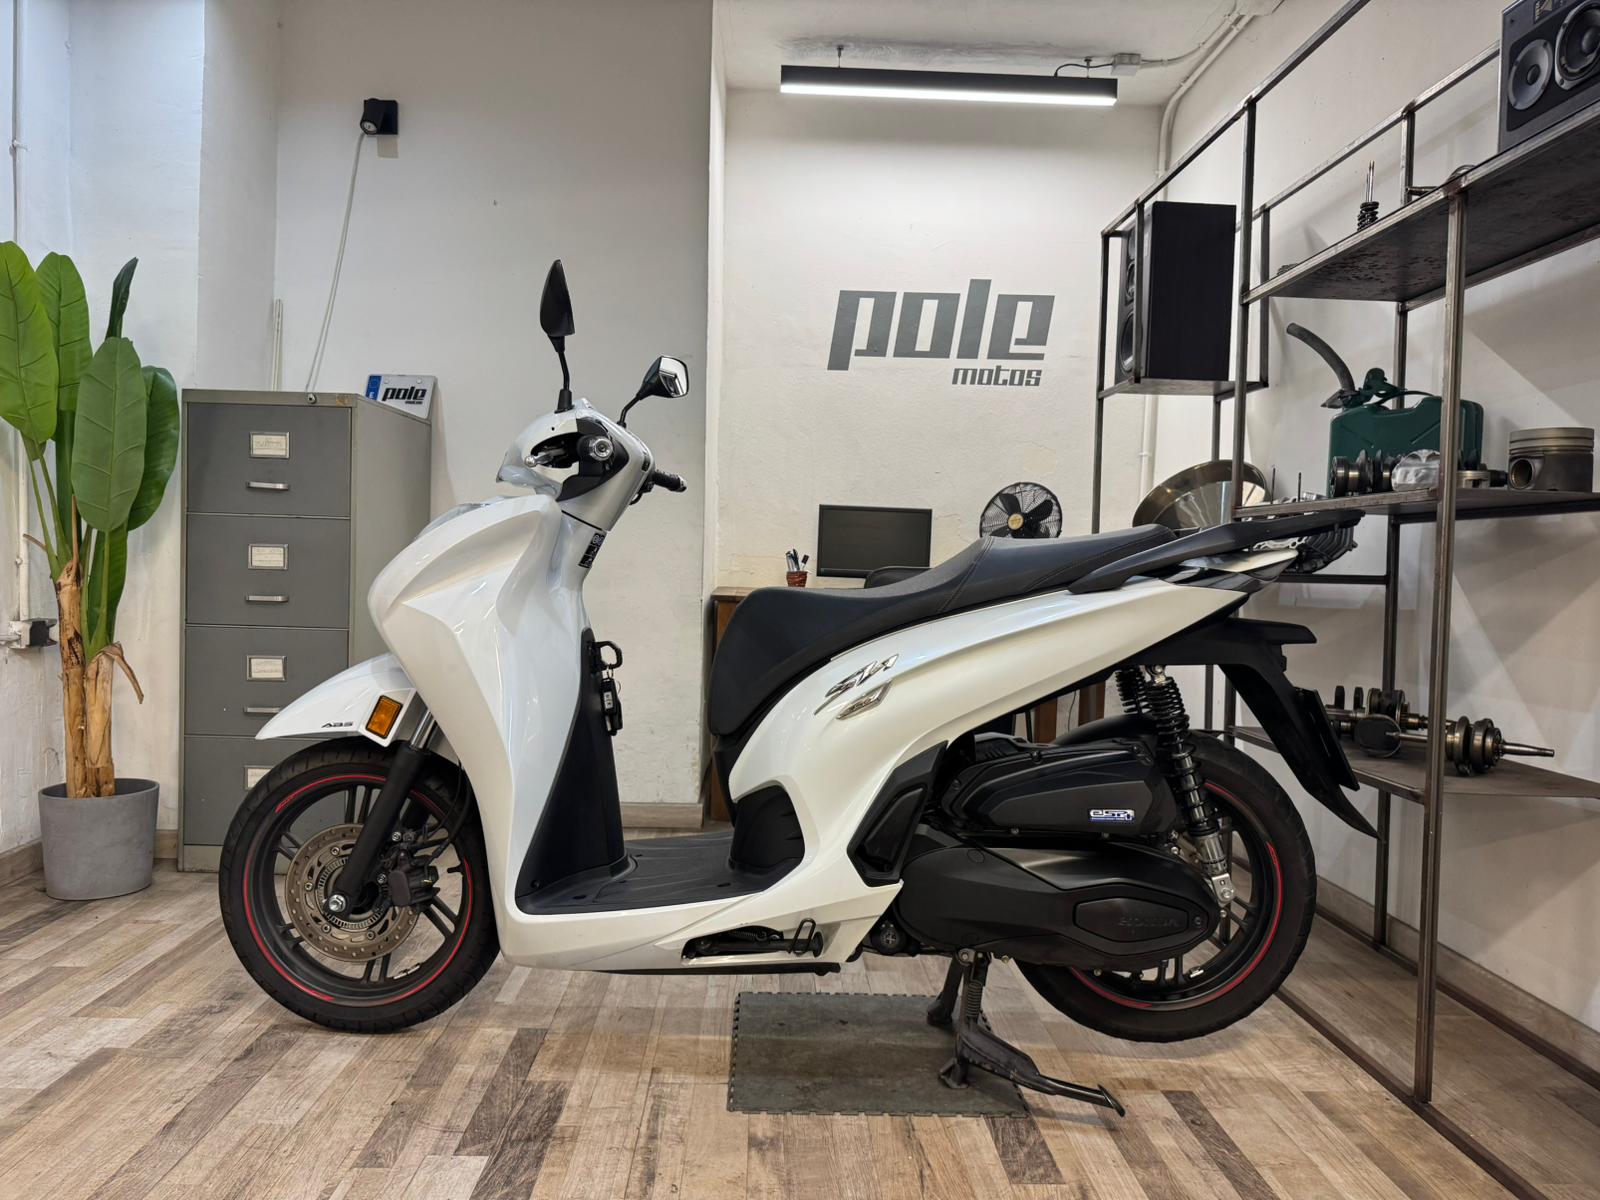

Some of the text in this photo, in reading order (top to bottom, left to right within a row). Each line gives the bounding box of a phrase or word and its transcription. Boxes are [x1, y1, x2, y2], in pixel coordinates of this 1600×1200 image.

[827, 279, 1055, 371] pole
[952, 365, 1042, 387] motos
[381, 386, 427, 401] pole
